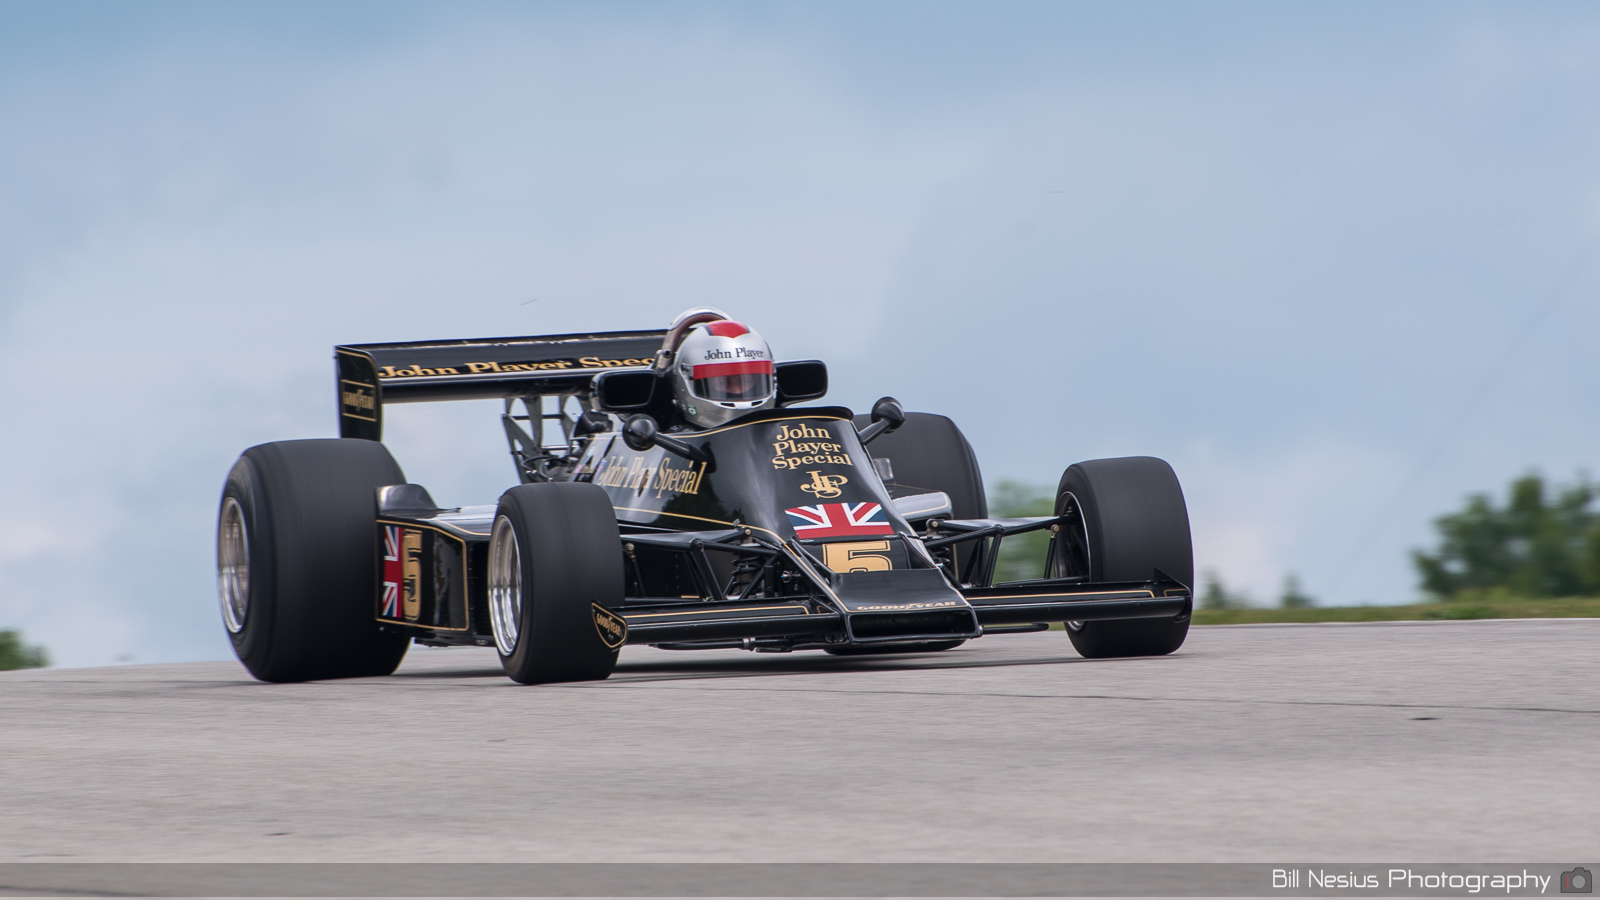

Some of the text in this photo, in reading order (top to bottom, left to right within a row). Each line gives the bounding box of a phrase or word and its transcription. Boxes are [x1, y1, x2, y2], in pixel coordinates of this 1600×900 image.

[704, 347, 764, 360] John Player
[378, 365, 459, 378] John
[578, 356, 656, 368] Spec
[776, 423, 832, 441] John
[772, 440, 842, 456] Player
[771, 452, 854, 470] Special
[597, 455, 629, 487] John
[653, 457, 708, 499] Special
